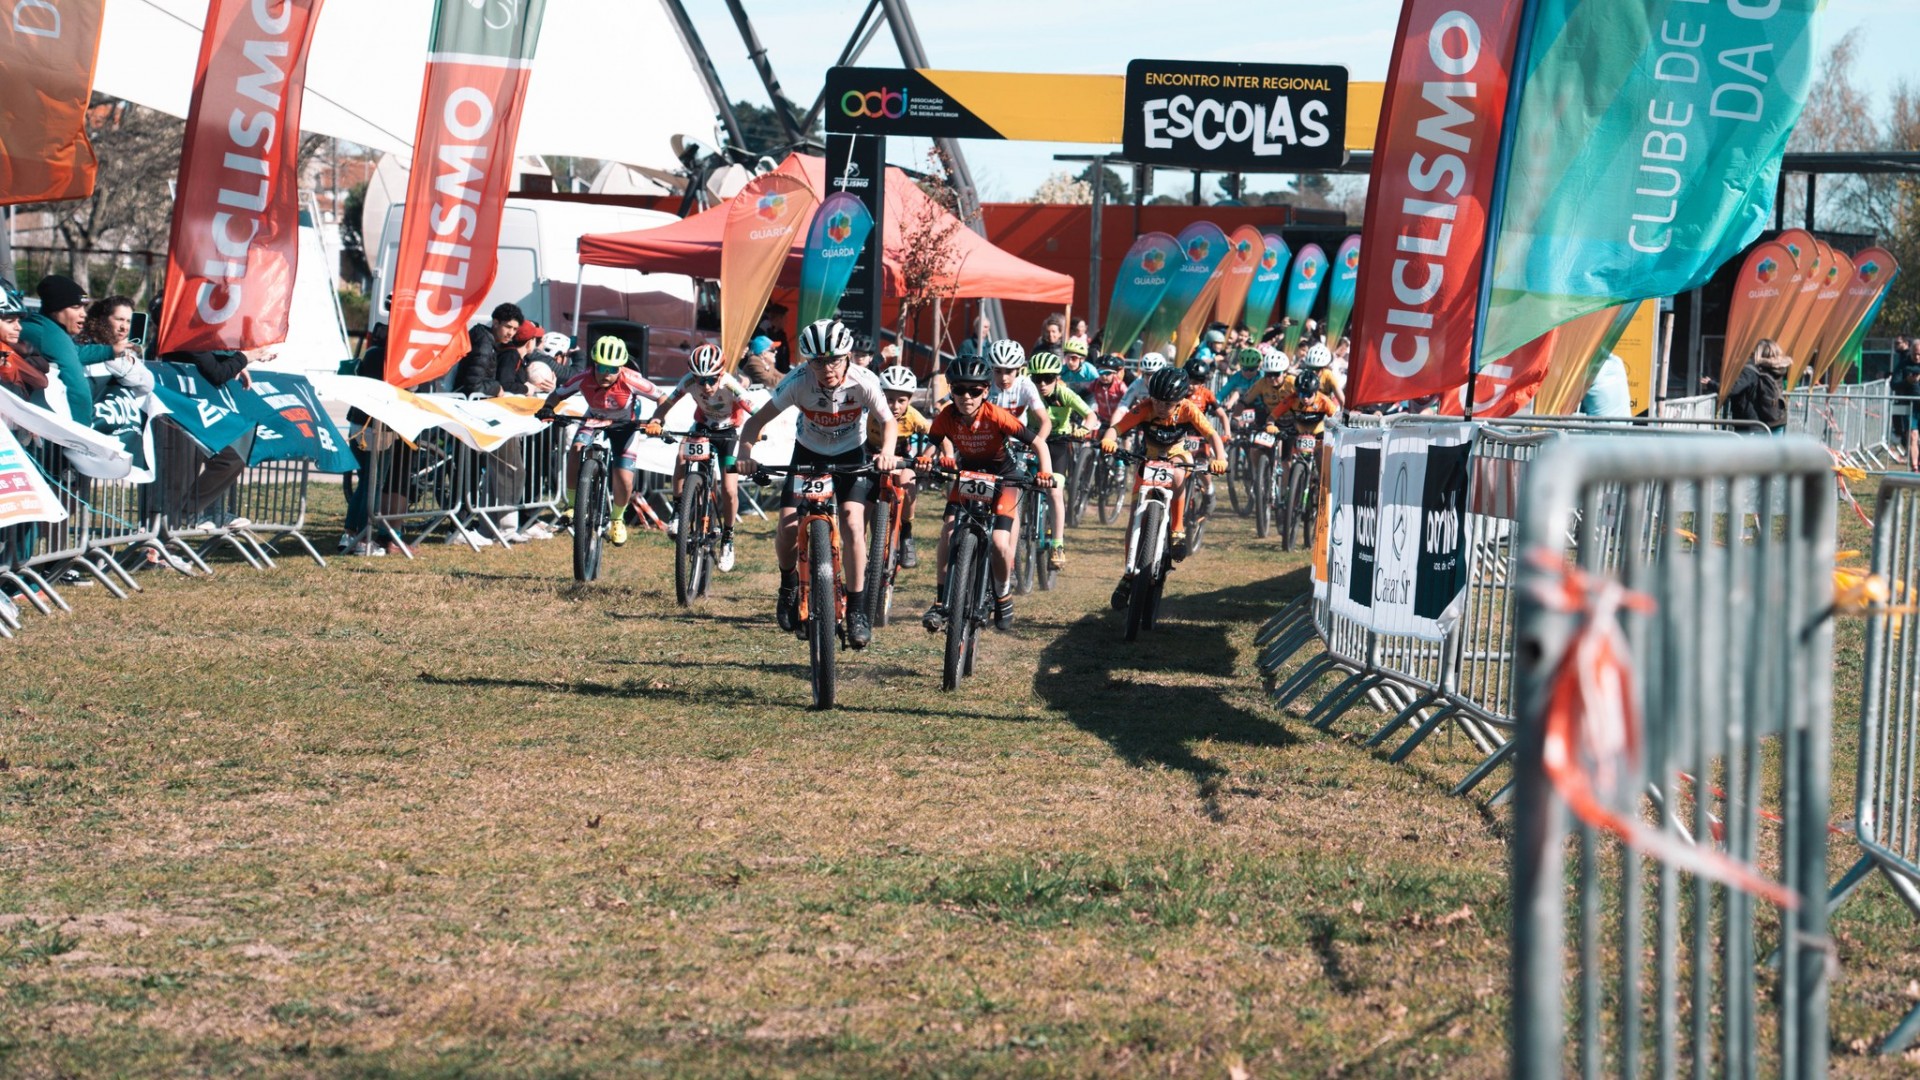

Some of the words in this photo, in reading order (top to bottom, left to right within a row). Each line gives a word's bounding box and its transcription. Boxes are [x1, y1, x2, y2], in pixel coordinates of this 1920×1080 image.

[1654, 19, 1706, 84] DE
[1145, 72, 1220, 87] ENCONTRO
[1222, 76, 1259, 88] INTER
[1262, 77, 1331, 91] REGIONAL
[1709, 42, 1774, 122] DA
[1142, 94, 1330, 156] ESCOLAS
[1628, 98, 1694, 253] CLUBE
[1380, 10, 1481, 377] CICLISMO
[399, 86, 494, 379] CICLISMO
[749, 226, 793, 240] GUARDA
[822, 247, 855, 258] GUARDA
[1134, 277, 1166, 285] GUARDA
[1748, 288, 1779, 298] GUARDA
[1817, 290, 1840, 299] UARDA
[813, 412, 855, 426] ÁGUIAS
[688, 444, 704, 455] 58
[1150, 468, 1168, 481] 73
[801, 481, 824, 493] 29
[966, 480, 987, 495] 30
